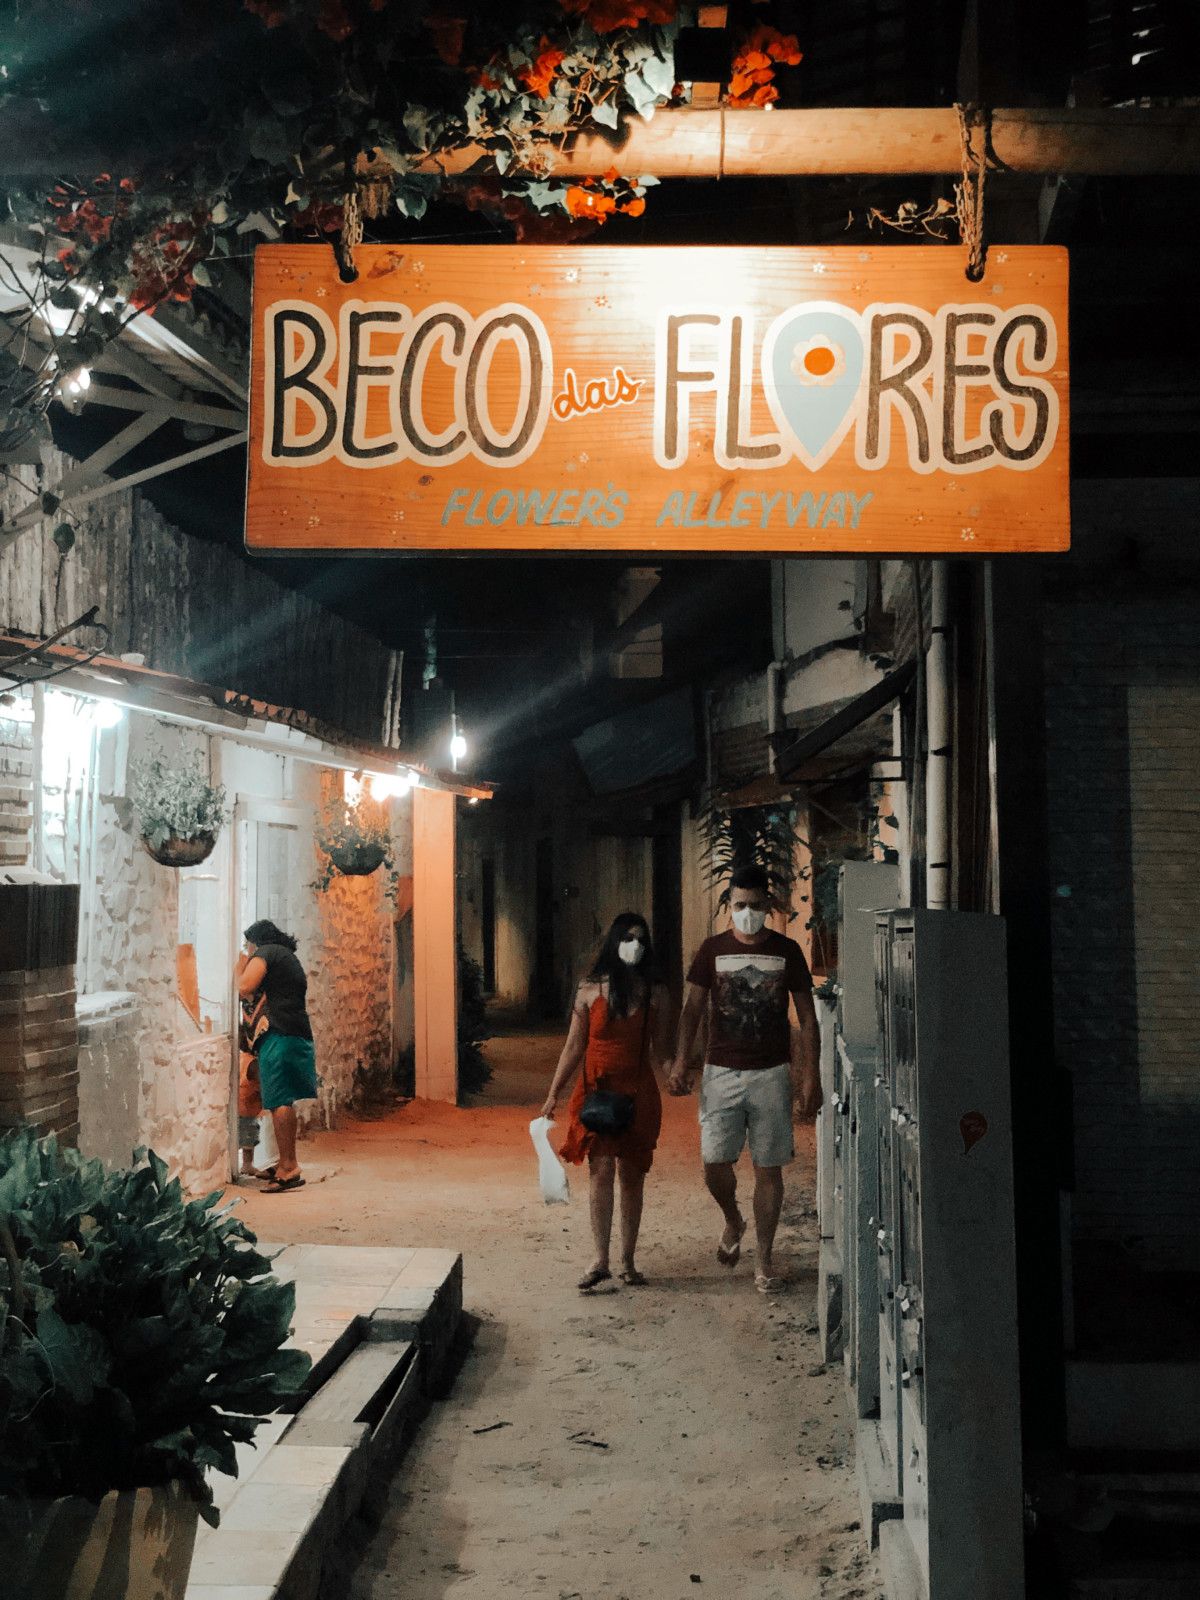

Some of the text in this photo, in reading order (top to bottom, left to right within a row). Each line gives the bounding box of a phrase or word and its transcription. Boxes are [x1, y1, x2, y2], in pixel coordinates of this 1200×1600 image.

[267, 302, 1054, 469] BECO das FLORES
[440, 481, 874, 529] FLOWER'S ALLEYWAY
